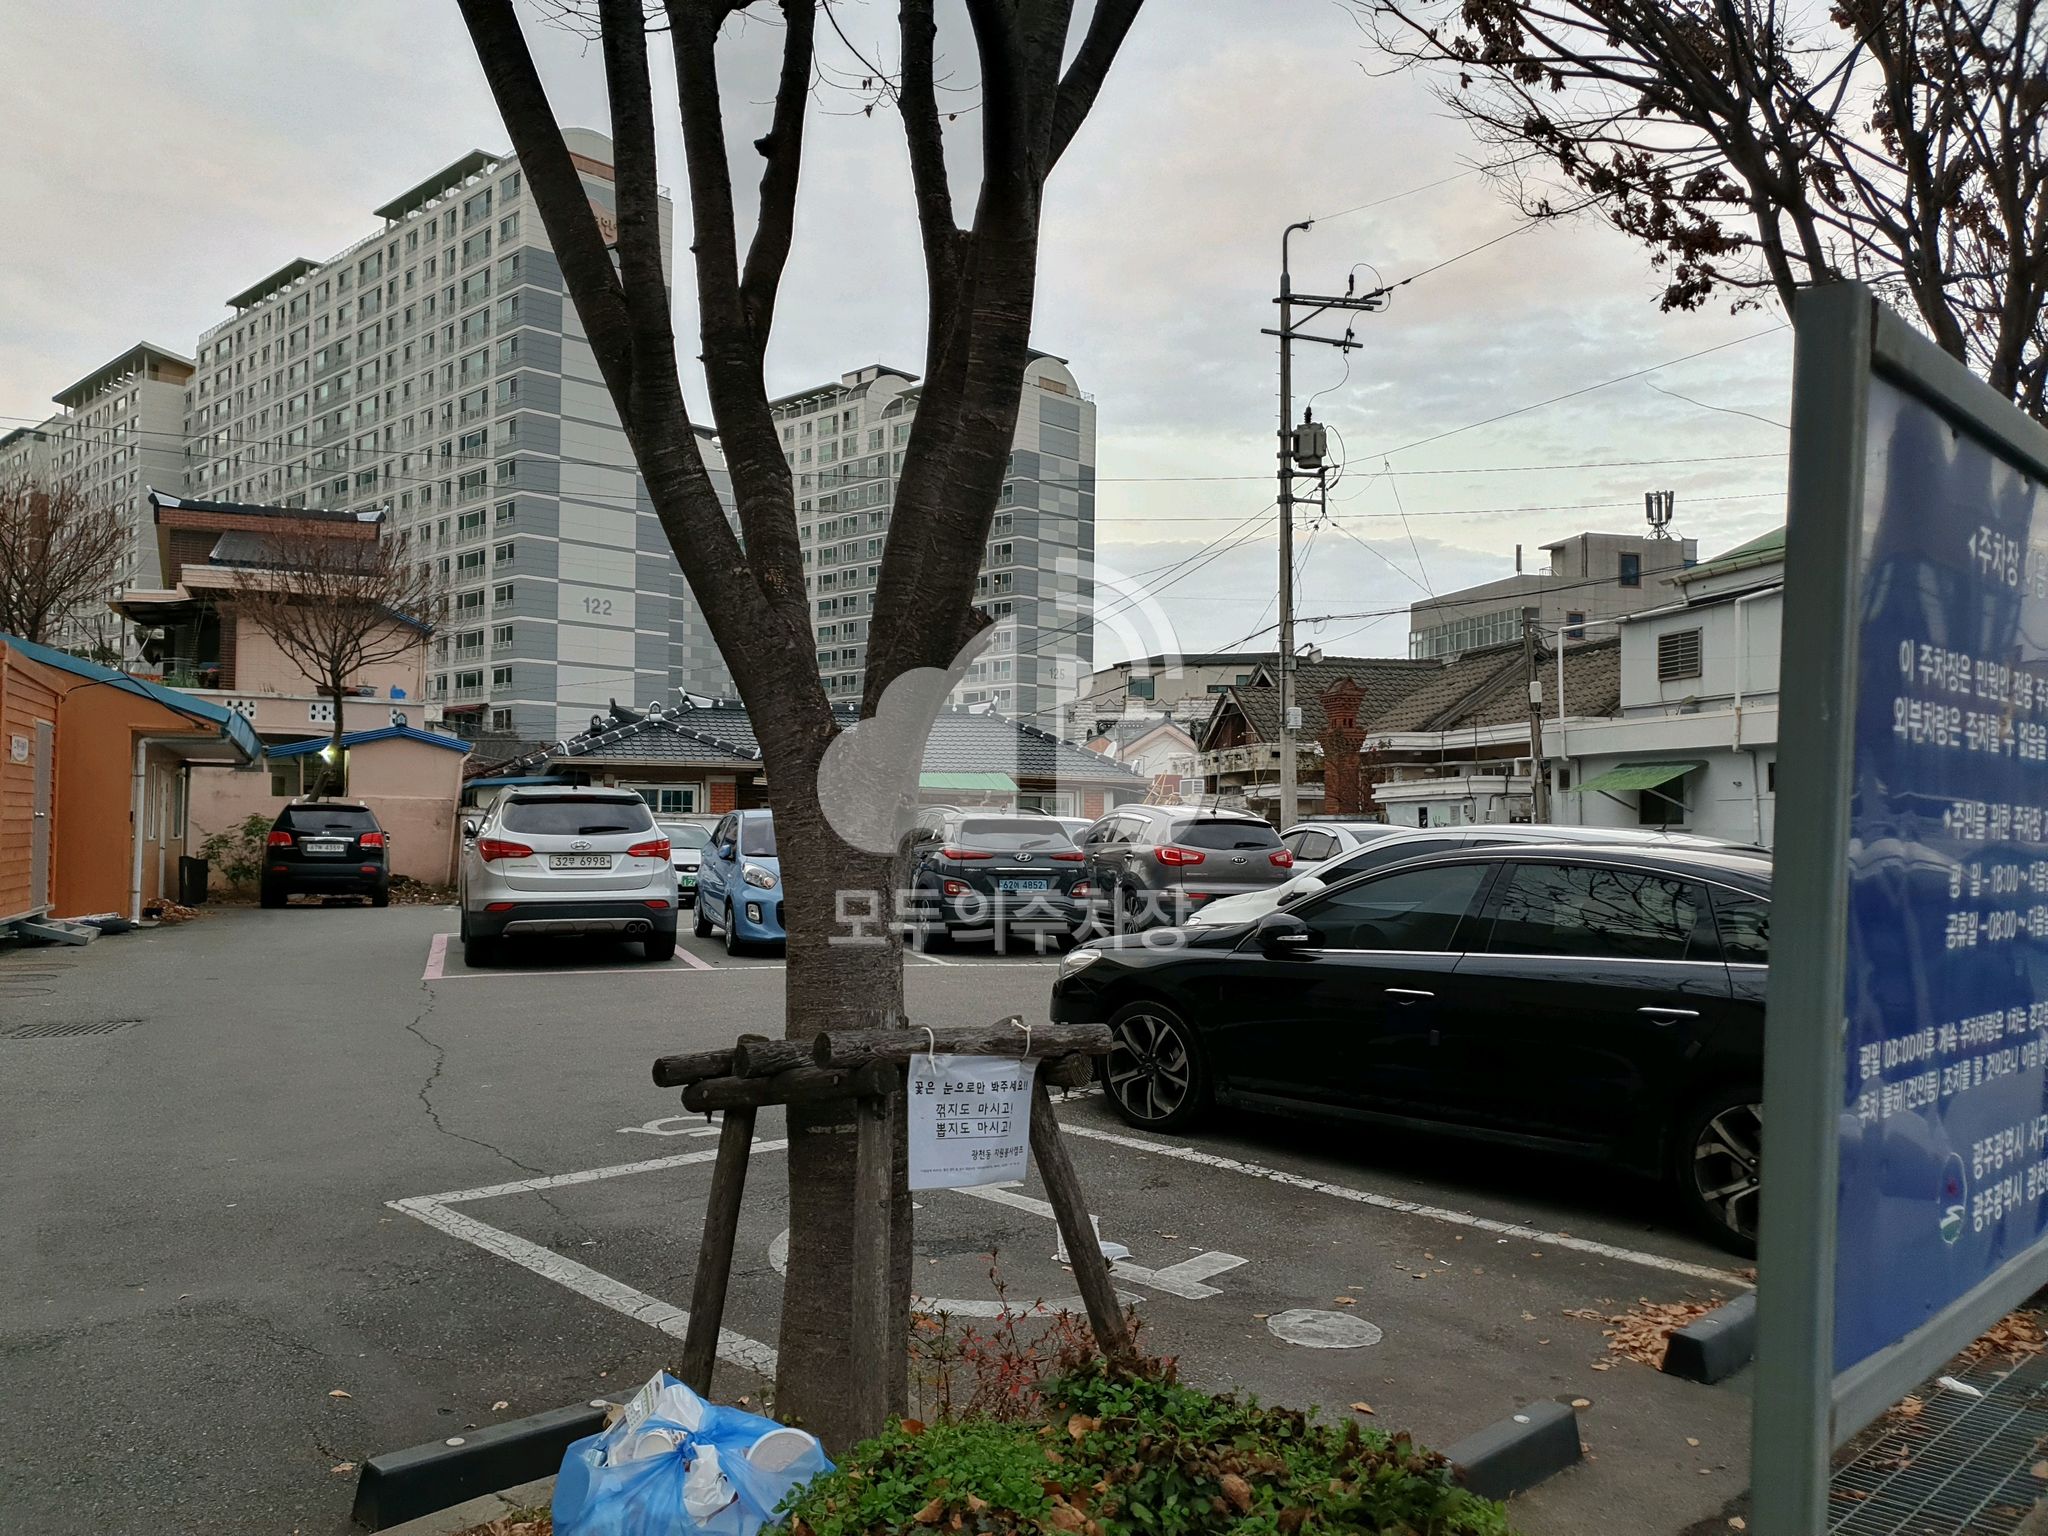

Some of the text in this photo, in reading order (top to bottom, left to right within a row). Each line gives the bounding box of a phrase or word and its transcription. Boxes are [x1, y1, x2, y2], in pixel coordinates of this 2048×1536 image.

[1979, 526, 2019, 586] 주차장
[583, 597, 612, 616] 122
[1900, 640, 1914, 682] 이
[1918, 644, 1972, 694] 주차장은
[1952, 802, 1986, 840] 주민을
[1990, 804, 2011, 840] 위한
[580, 857, 606, 866] 6998
[1022, 881, 1043, 889] 4852
[1941, 1059, 1971, 1096] 조치를
[915, 1080, 1028, 1095] 꽃은 눈으로만 봐주세요!!
[936, 1103, 1014, 1118] 꺾지도 마시고!
[936, 1121, 1012, 1137] 뽑지도 마시고!
[971, 1150, 991, 1160] 광천동
[1972, 1122, 2025, 1180] 광주광역시
[1972, 1171, 2023, 1233] 광주광역시
